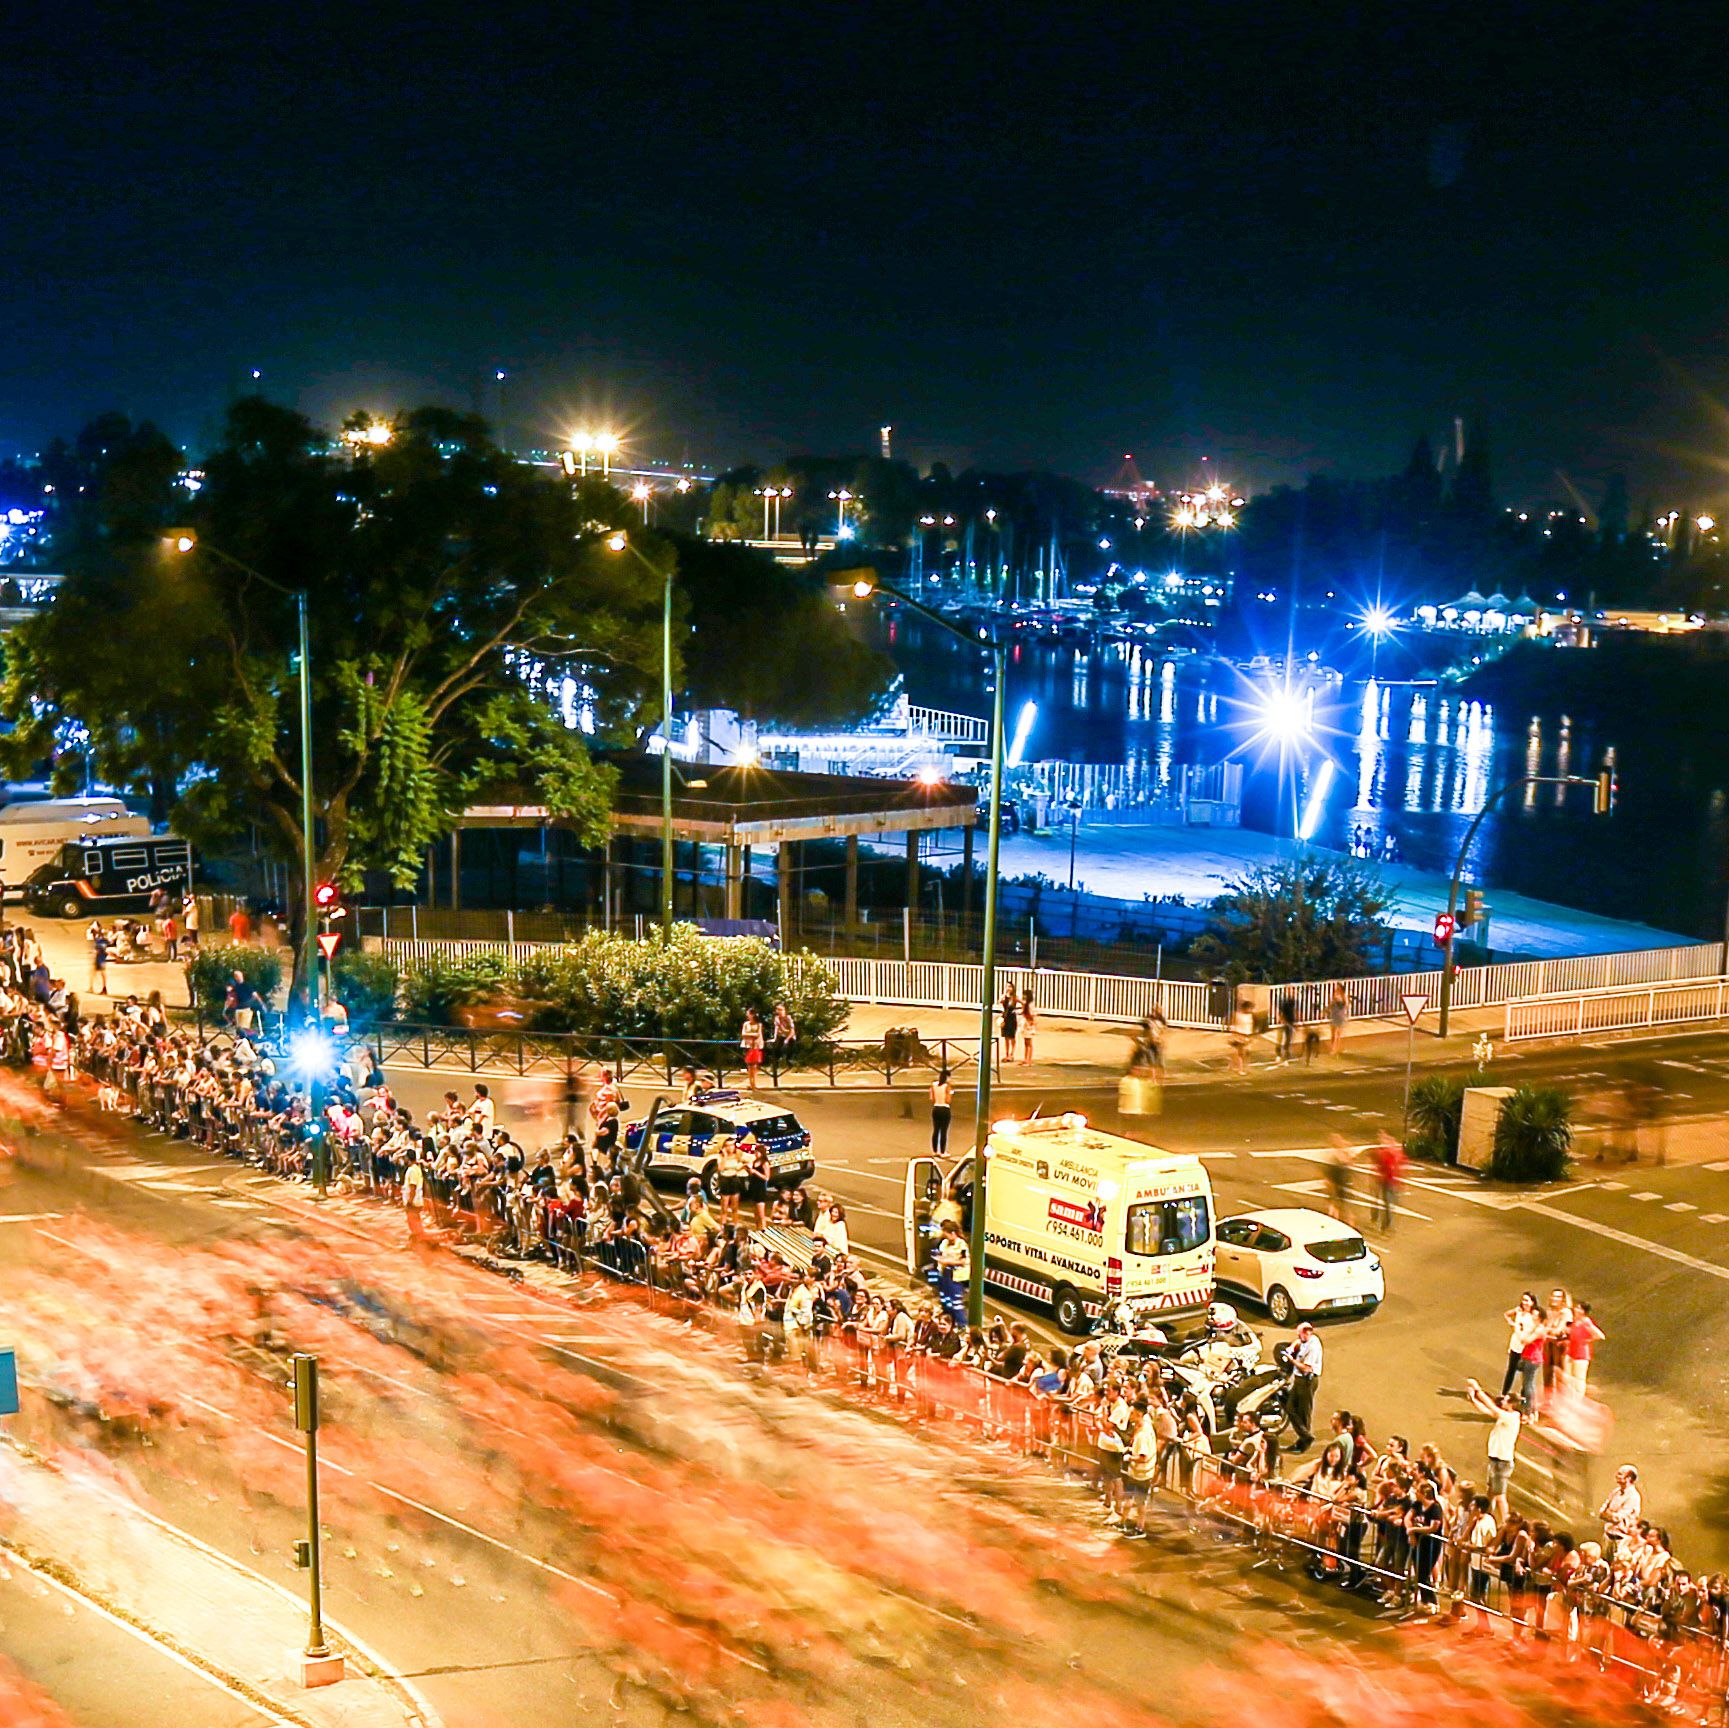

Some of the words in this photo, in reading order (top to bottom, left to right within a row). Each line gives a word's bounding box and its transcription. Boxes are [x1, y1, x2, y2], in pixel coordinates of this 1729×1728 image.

[1054, 1169, 1070, 1182] UVI
[1071, 1175, 1098, 1191] MOVI
[984, 1232, 1021, 1254] SOPORTE
[1025, 1246, 1048, 1262] VITAL
[1051, 1255, 1101, 1279] AVANZADO
